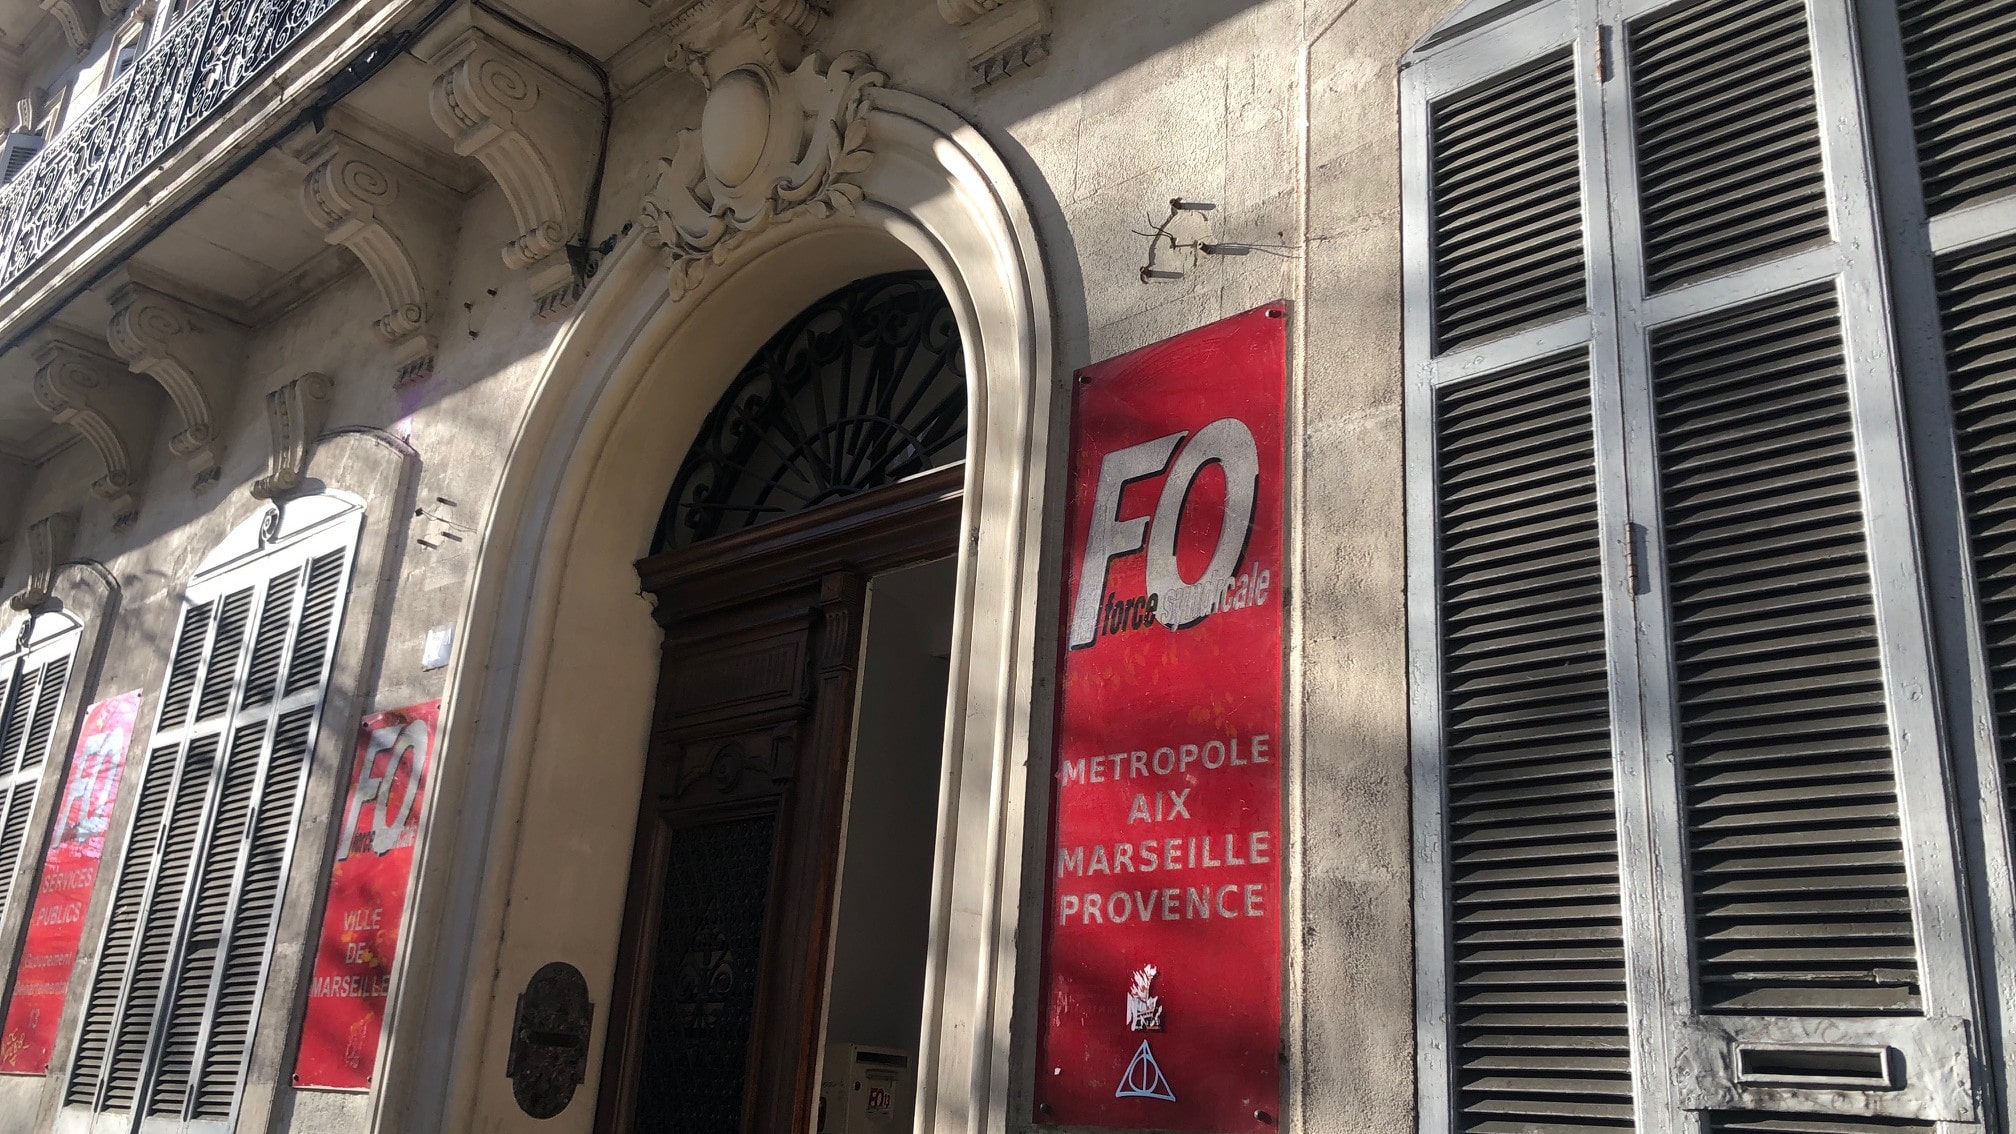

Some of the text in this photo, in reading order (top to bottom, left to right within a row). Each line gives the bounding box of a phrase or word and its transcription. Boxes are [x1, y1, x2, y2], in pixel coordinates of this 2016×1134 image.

[1070, 418, 1259, 651] FO
[1102, 592, 1158, 636] force
[1061, 734, 1271, 787] METROPOLE
[51, 726, 124, 849] FO
[338, 719, 428, 861] FO
[1127, 788, 1191, 824] AIX
[1057, 831, 1270, 878] MARSEILLE
[42, 867, 94, 894] SERVICES
[37, 902, 82, 927] PUBLICS
[343, 908, 383, 931] VILLE
[1059, 883, 1265, 926] PROVENCE
[345, 942, 367, 964] DE
[309, 975, 390, 998] MARSEILLE
